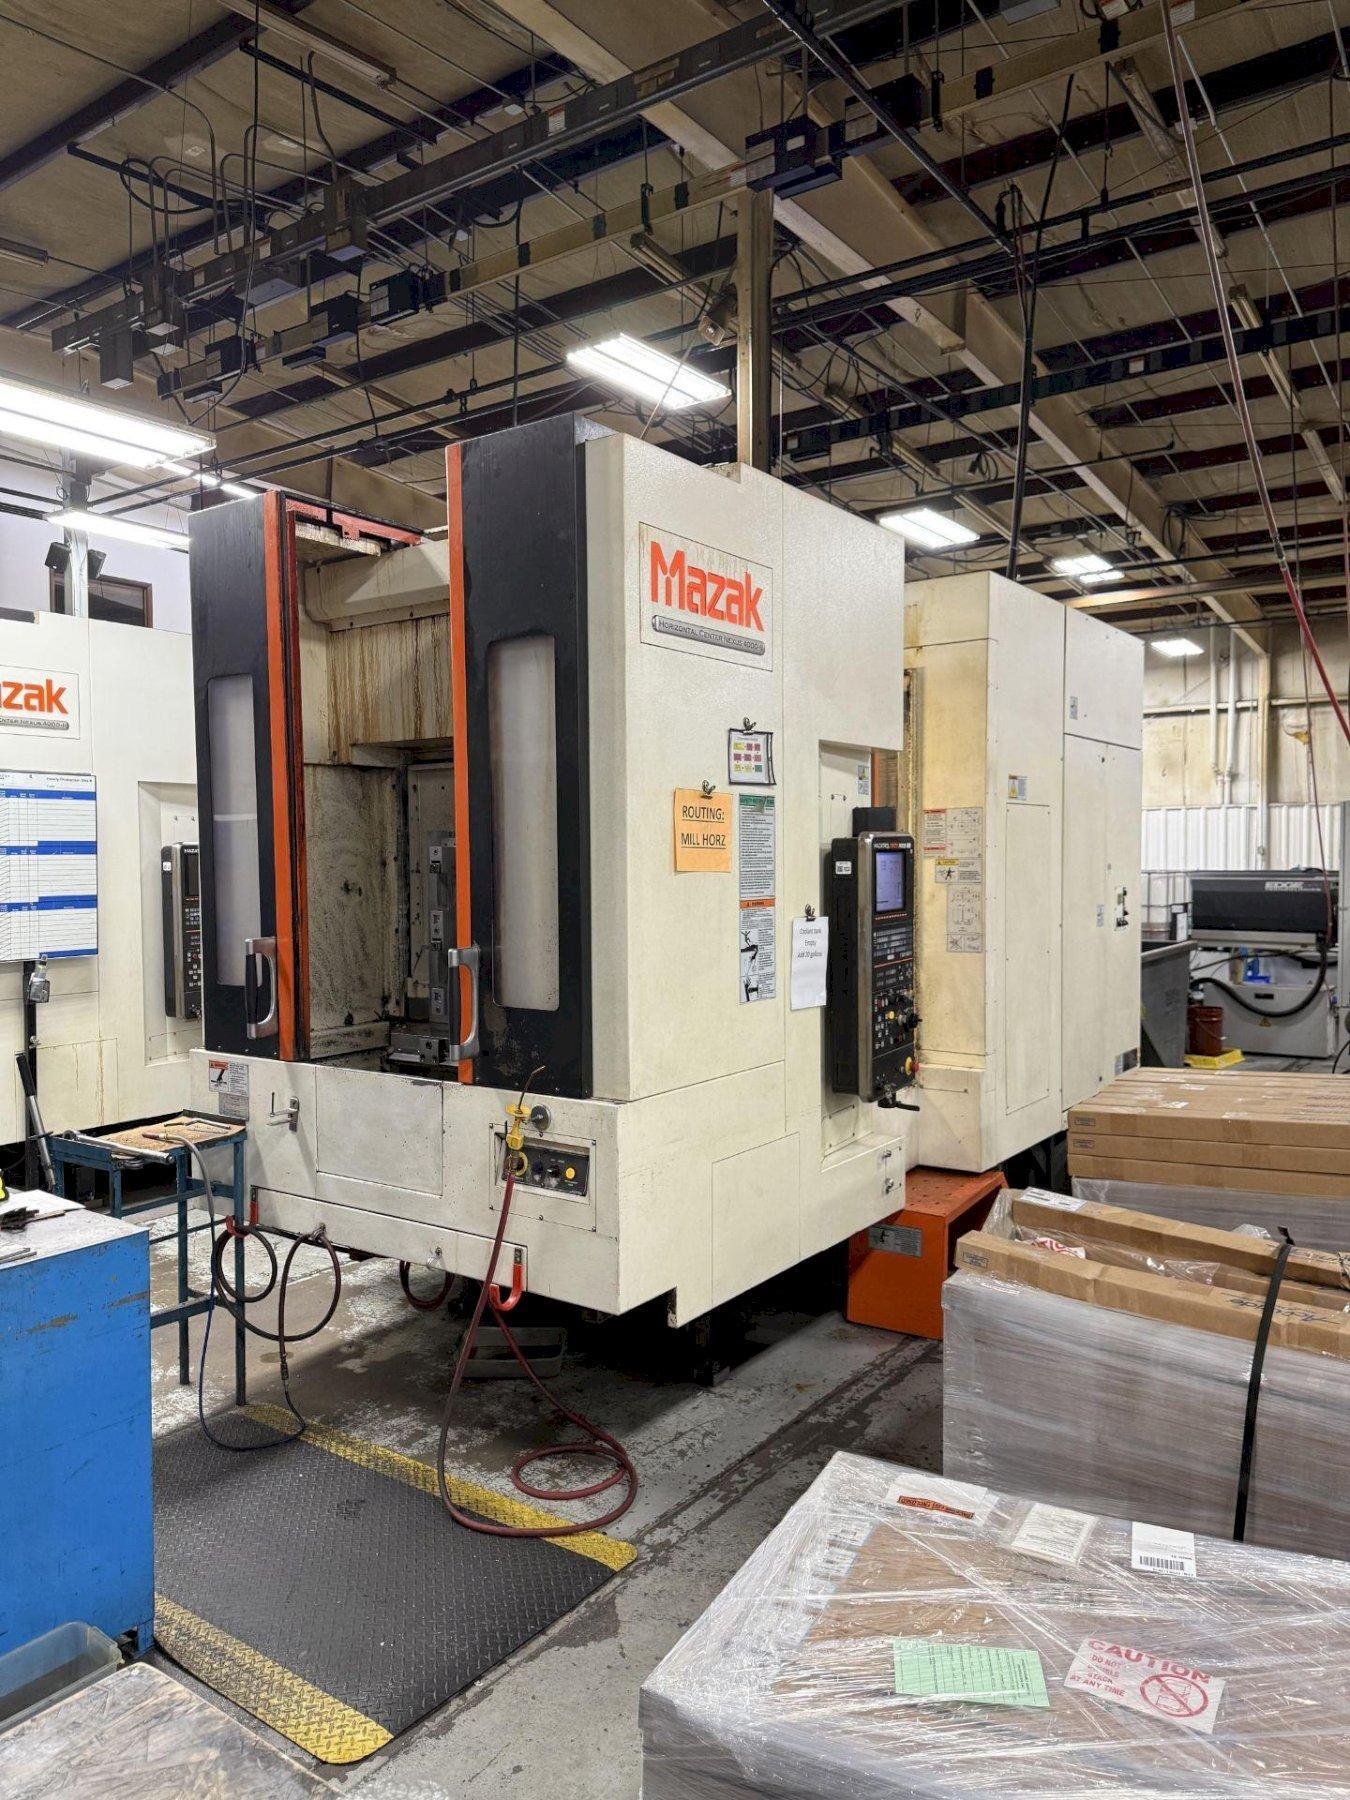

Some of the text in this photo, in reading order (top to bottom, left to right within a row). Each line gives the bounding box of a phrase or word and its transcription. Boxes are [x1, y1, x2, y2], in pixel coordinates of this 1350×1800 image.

[650, 541, 764, 632] Mazak
[682, 805, 725, 821] ROUTING:
[681, 833, 727, 847] MILL HORZ
[1088, 1640, 1211, 1684] CAUTION
[1091, 1655, 1104, 1664] DO
[1070, 1674, 1126, 1697] AT ANY TIME
